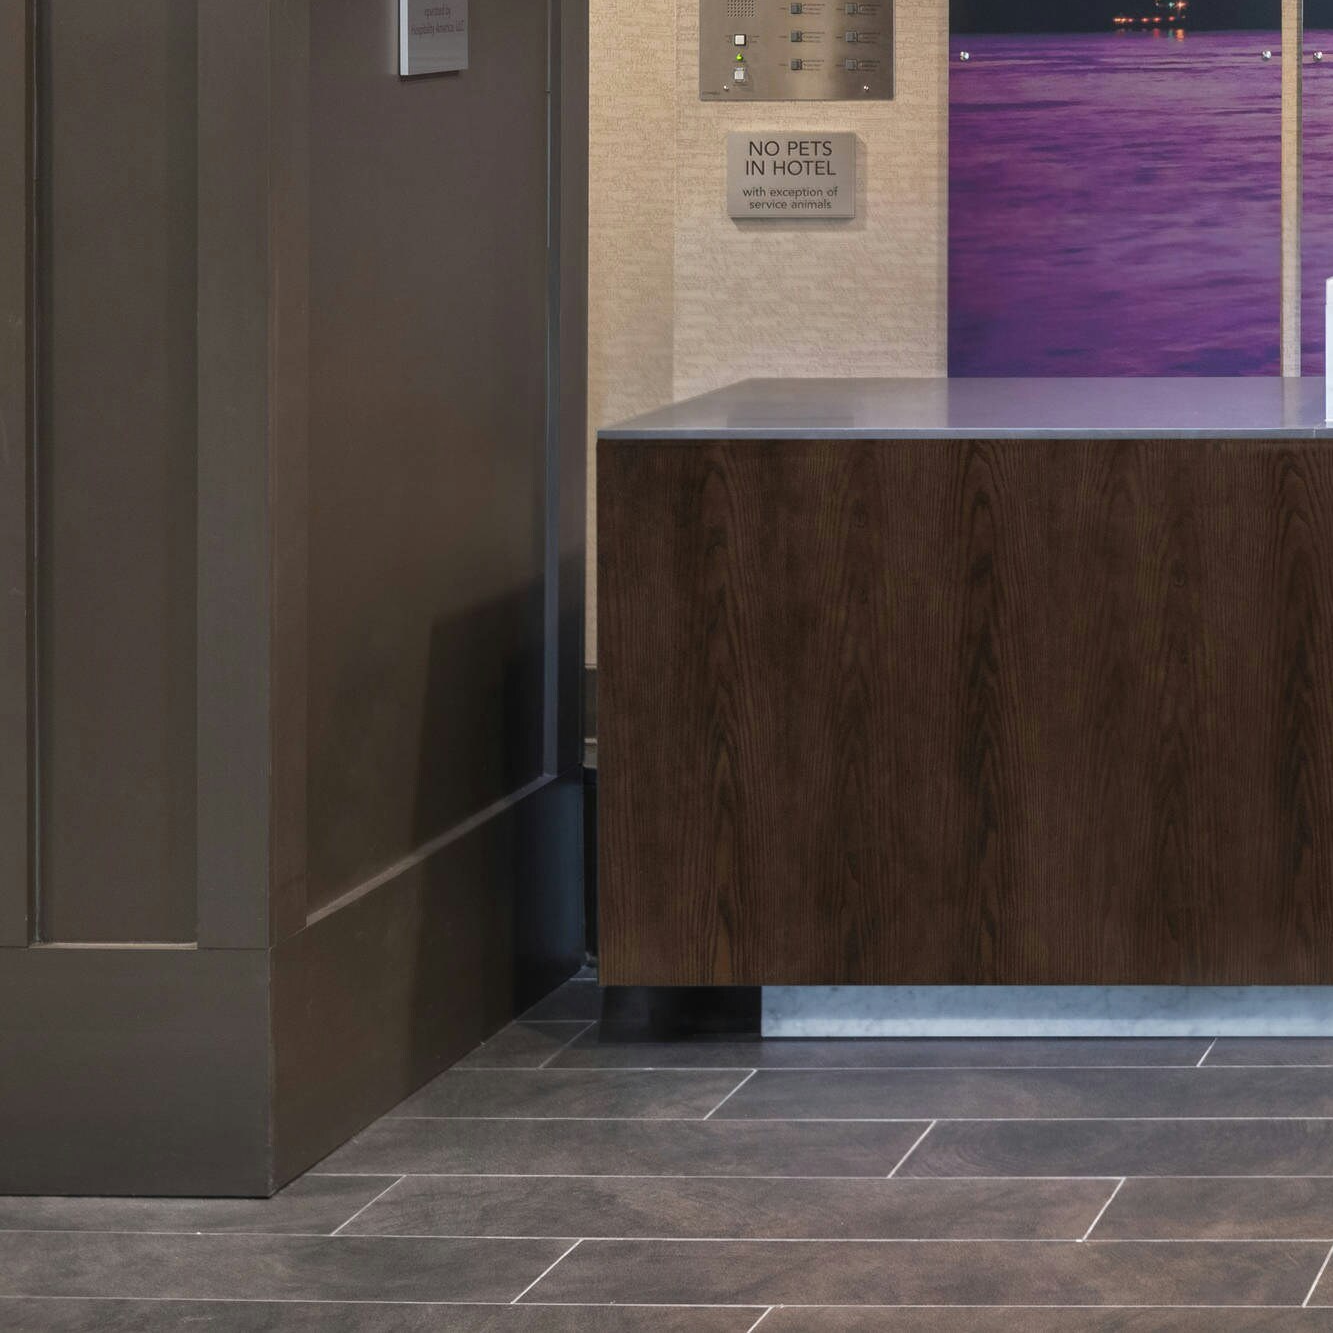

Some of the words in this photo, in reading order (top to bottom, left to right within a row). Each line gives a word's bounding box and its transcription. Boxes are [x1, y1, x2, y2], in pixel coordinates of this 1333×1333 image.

[749, 140, 780, 157] NO
[787, 140, 833, 157] PETS
[745, 160, 765, 176] IN
[773, 160, 837, 176] HOTEL
[743, 186, 766, 197] with
[770, 186, 823, 201] exception
[826, 185, 838, 197] of
[749, 199, 787, 210] service
[790, 198, 832, 210] animals
